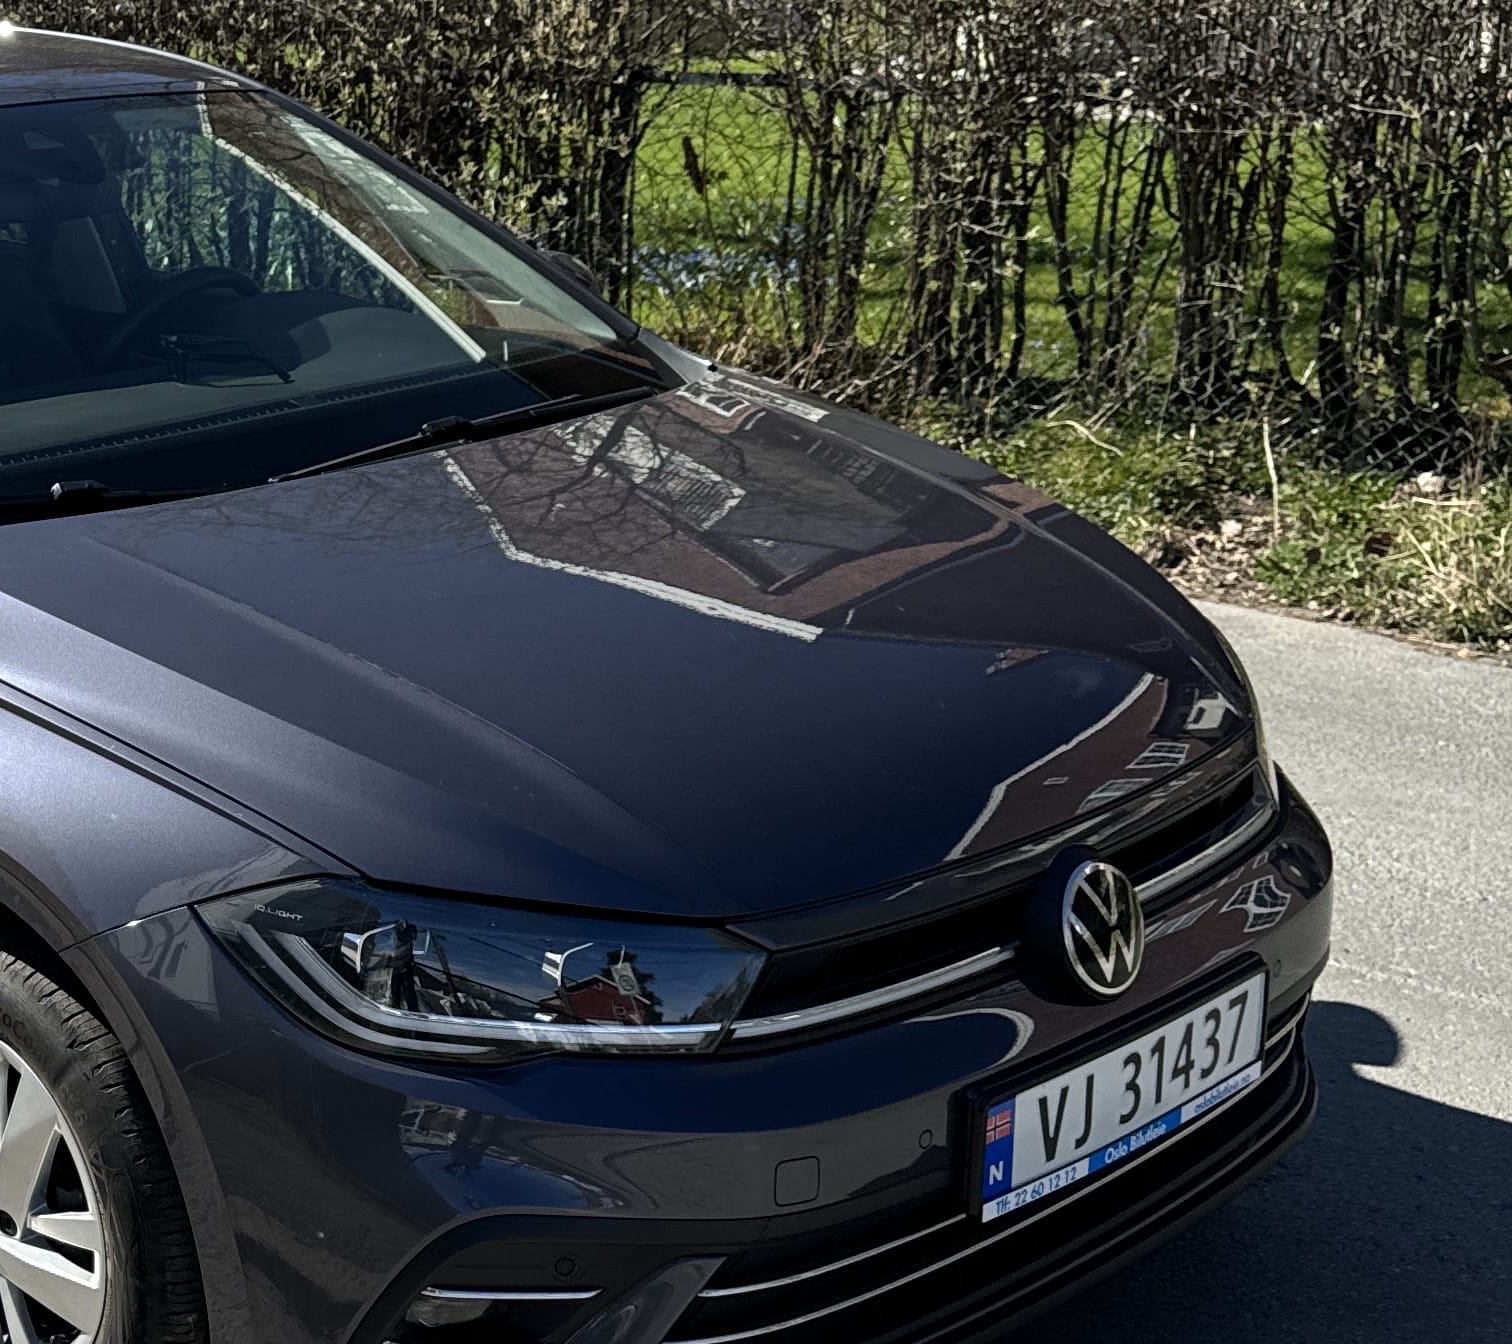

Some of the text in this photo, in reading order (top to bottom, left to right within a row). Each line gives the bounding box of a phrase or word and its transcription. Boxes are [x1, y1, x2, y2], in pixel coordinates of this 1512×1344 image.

[1038, 990, 1250, 1163] VJ 31437
[1104, 1141, 1128, 1164] Oslo
[988, 1160, 1004, 1186] N
[1014, 1188, 1028, 1207] 22
[1030, 1181, 1045, 1200] 60
[1049, 1174, 1061, 1191] 12
[1064, 1166, 1077, 1183] 12
